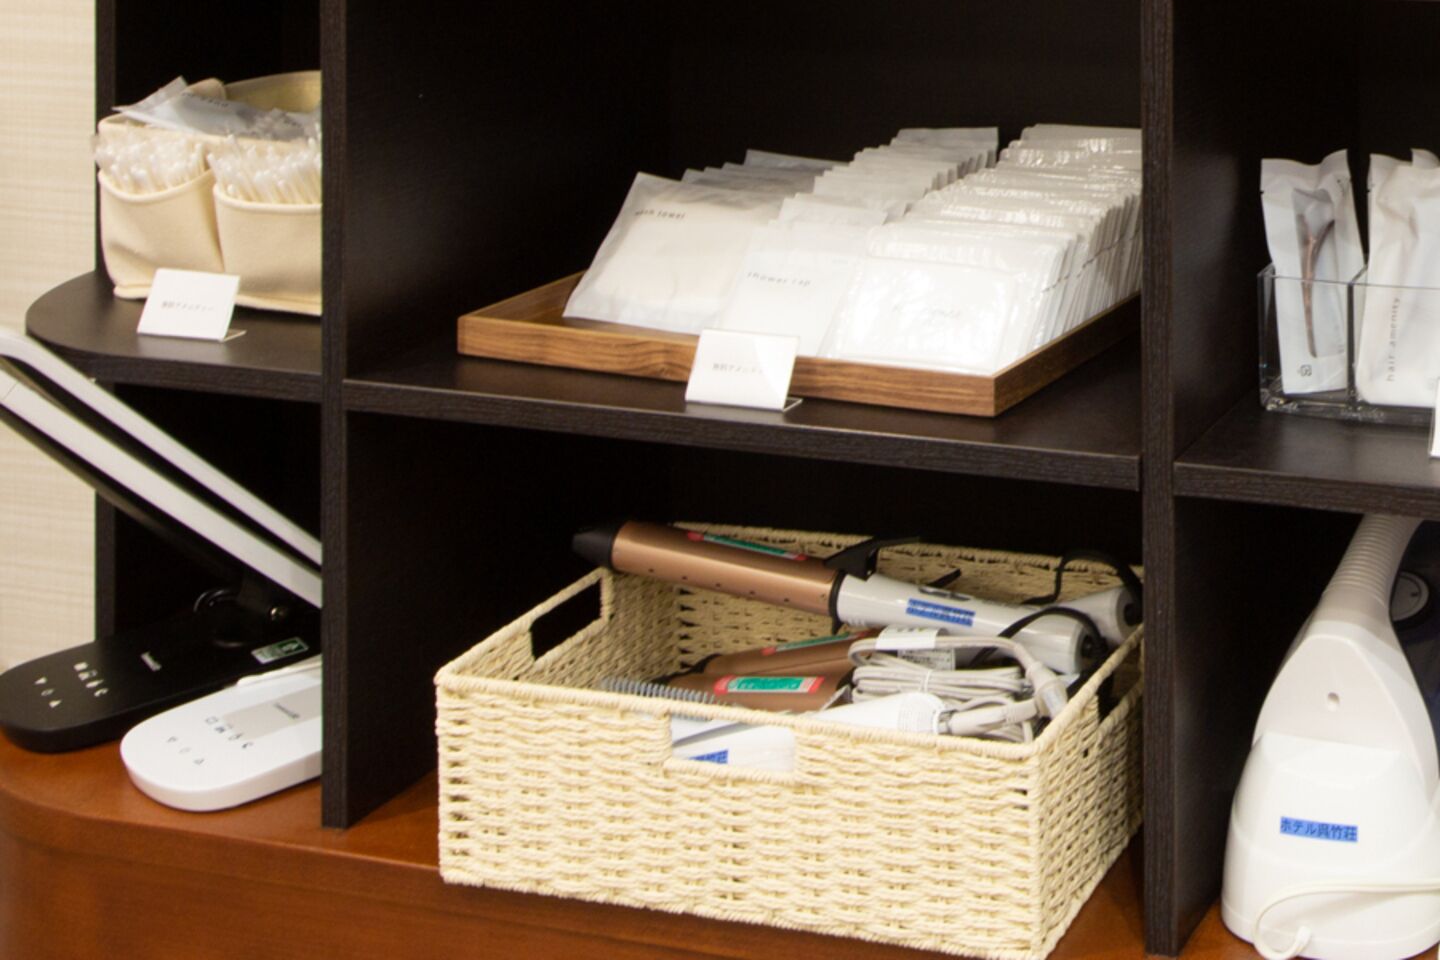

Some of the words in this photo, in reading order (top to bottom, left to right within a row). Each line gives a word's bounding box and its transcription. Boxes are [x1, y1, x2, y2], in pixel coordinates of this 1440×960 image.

[1280, 819, 1358, 842] ホテル呉竹荘
